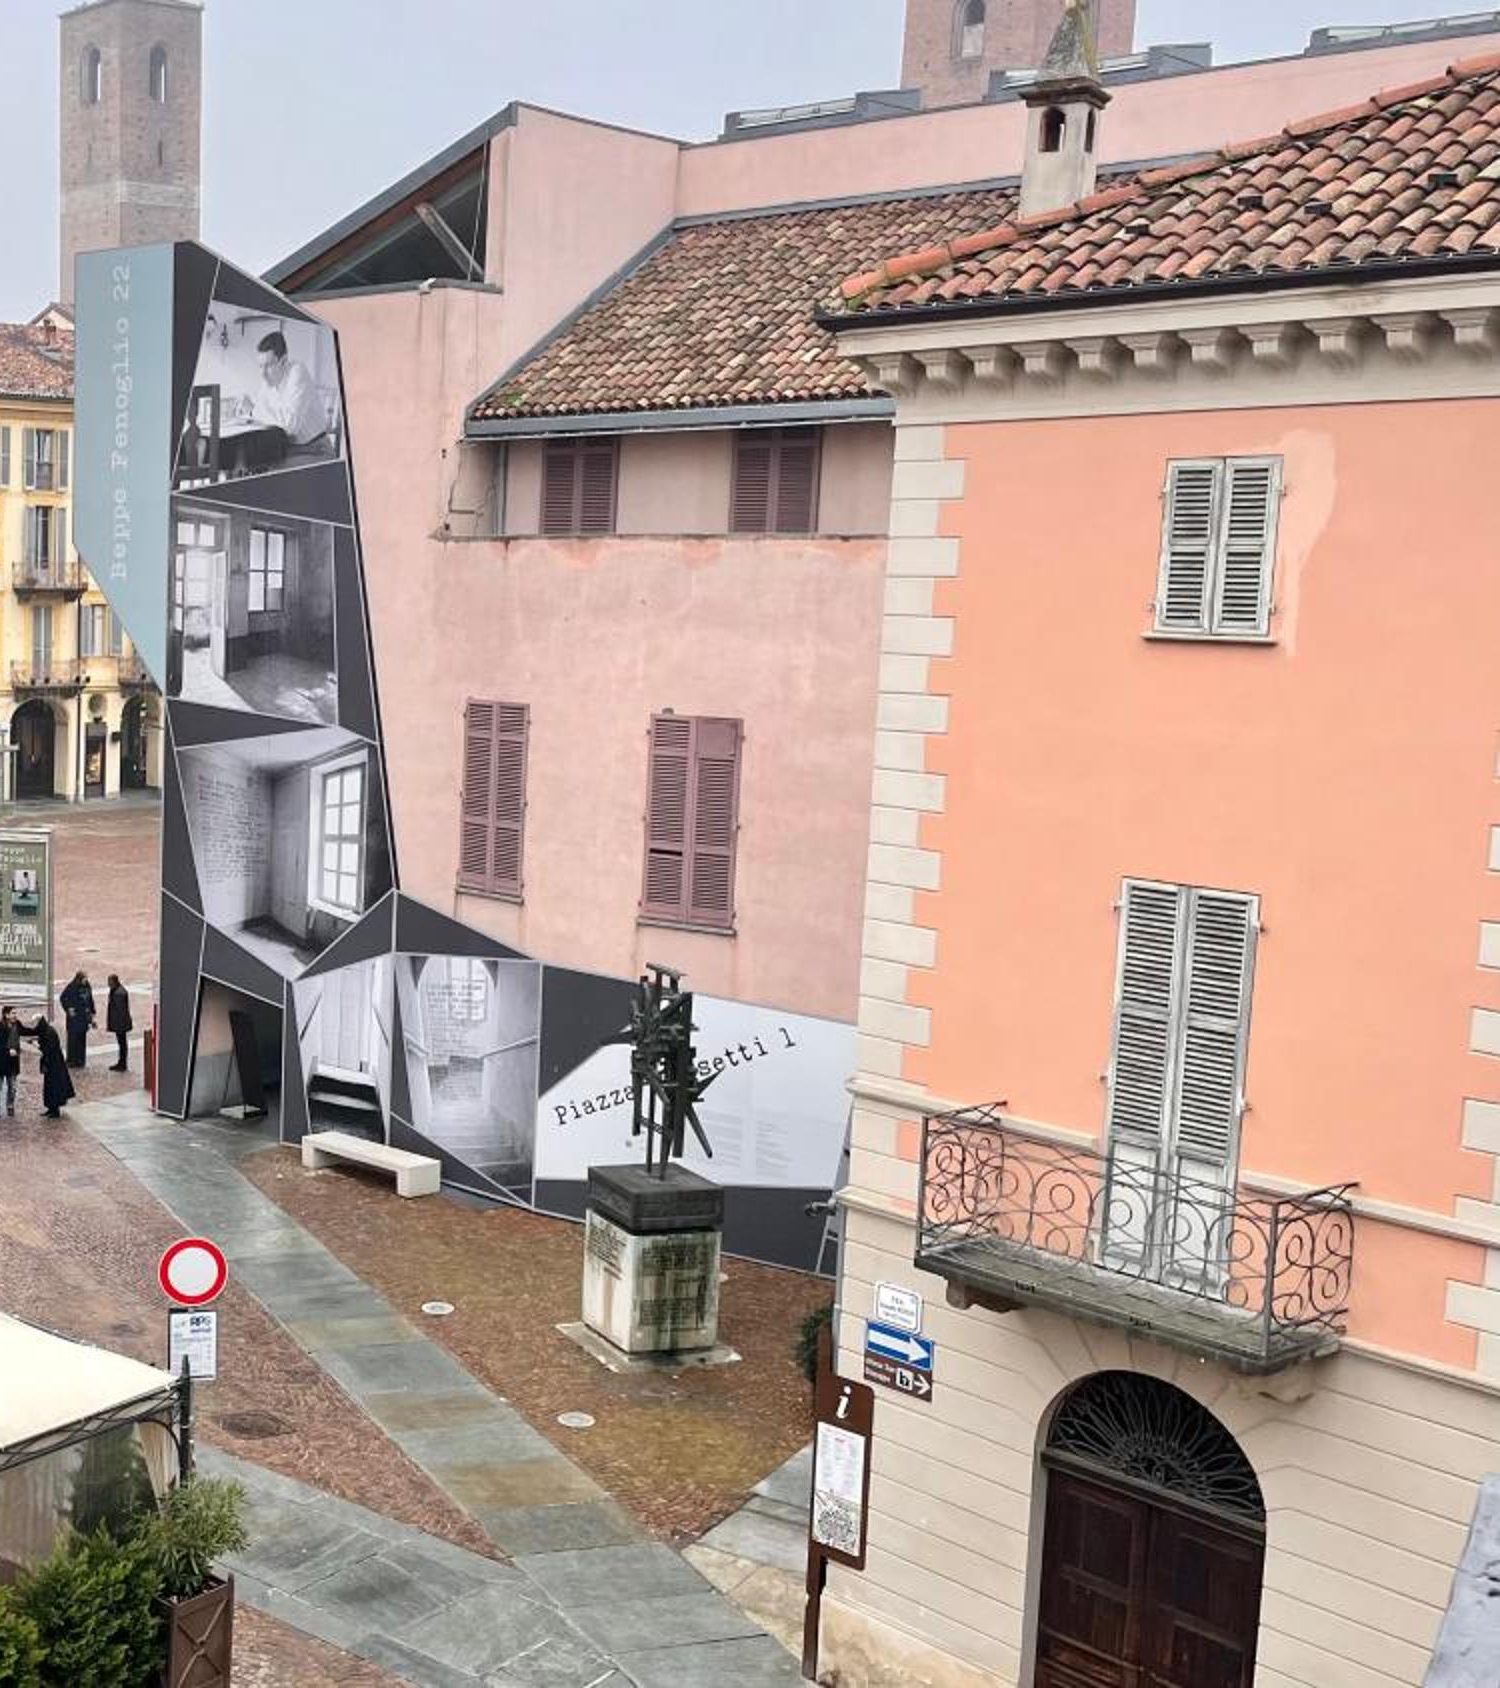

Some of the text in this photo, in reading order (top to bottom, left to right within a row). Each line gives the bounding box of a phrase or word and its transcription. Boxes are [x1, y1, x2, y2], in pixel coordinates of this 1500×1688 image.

[111, 264, 132, 579] Beppe Fenoglio 22
[555, 1086, 634, 1125] Piazza
